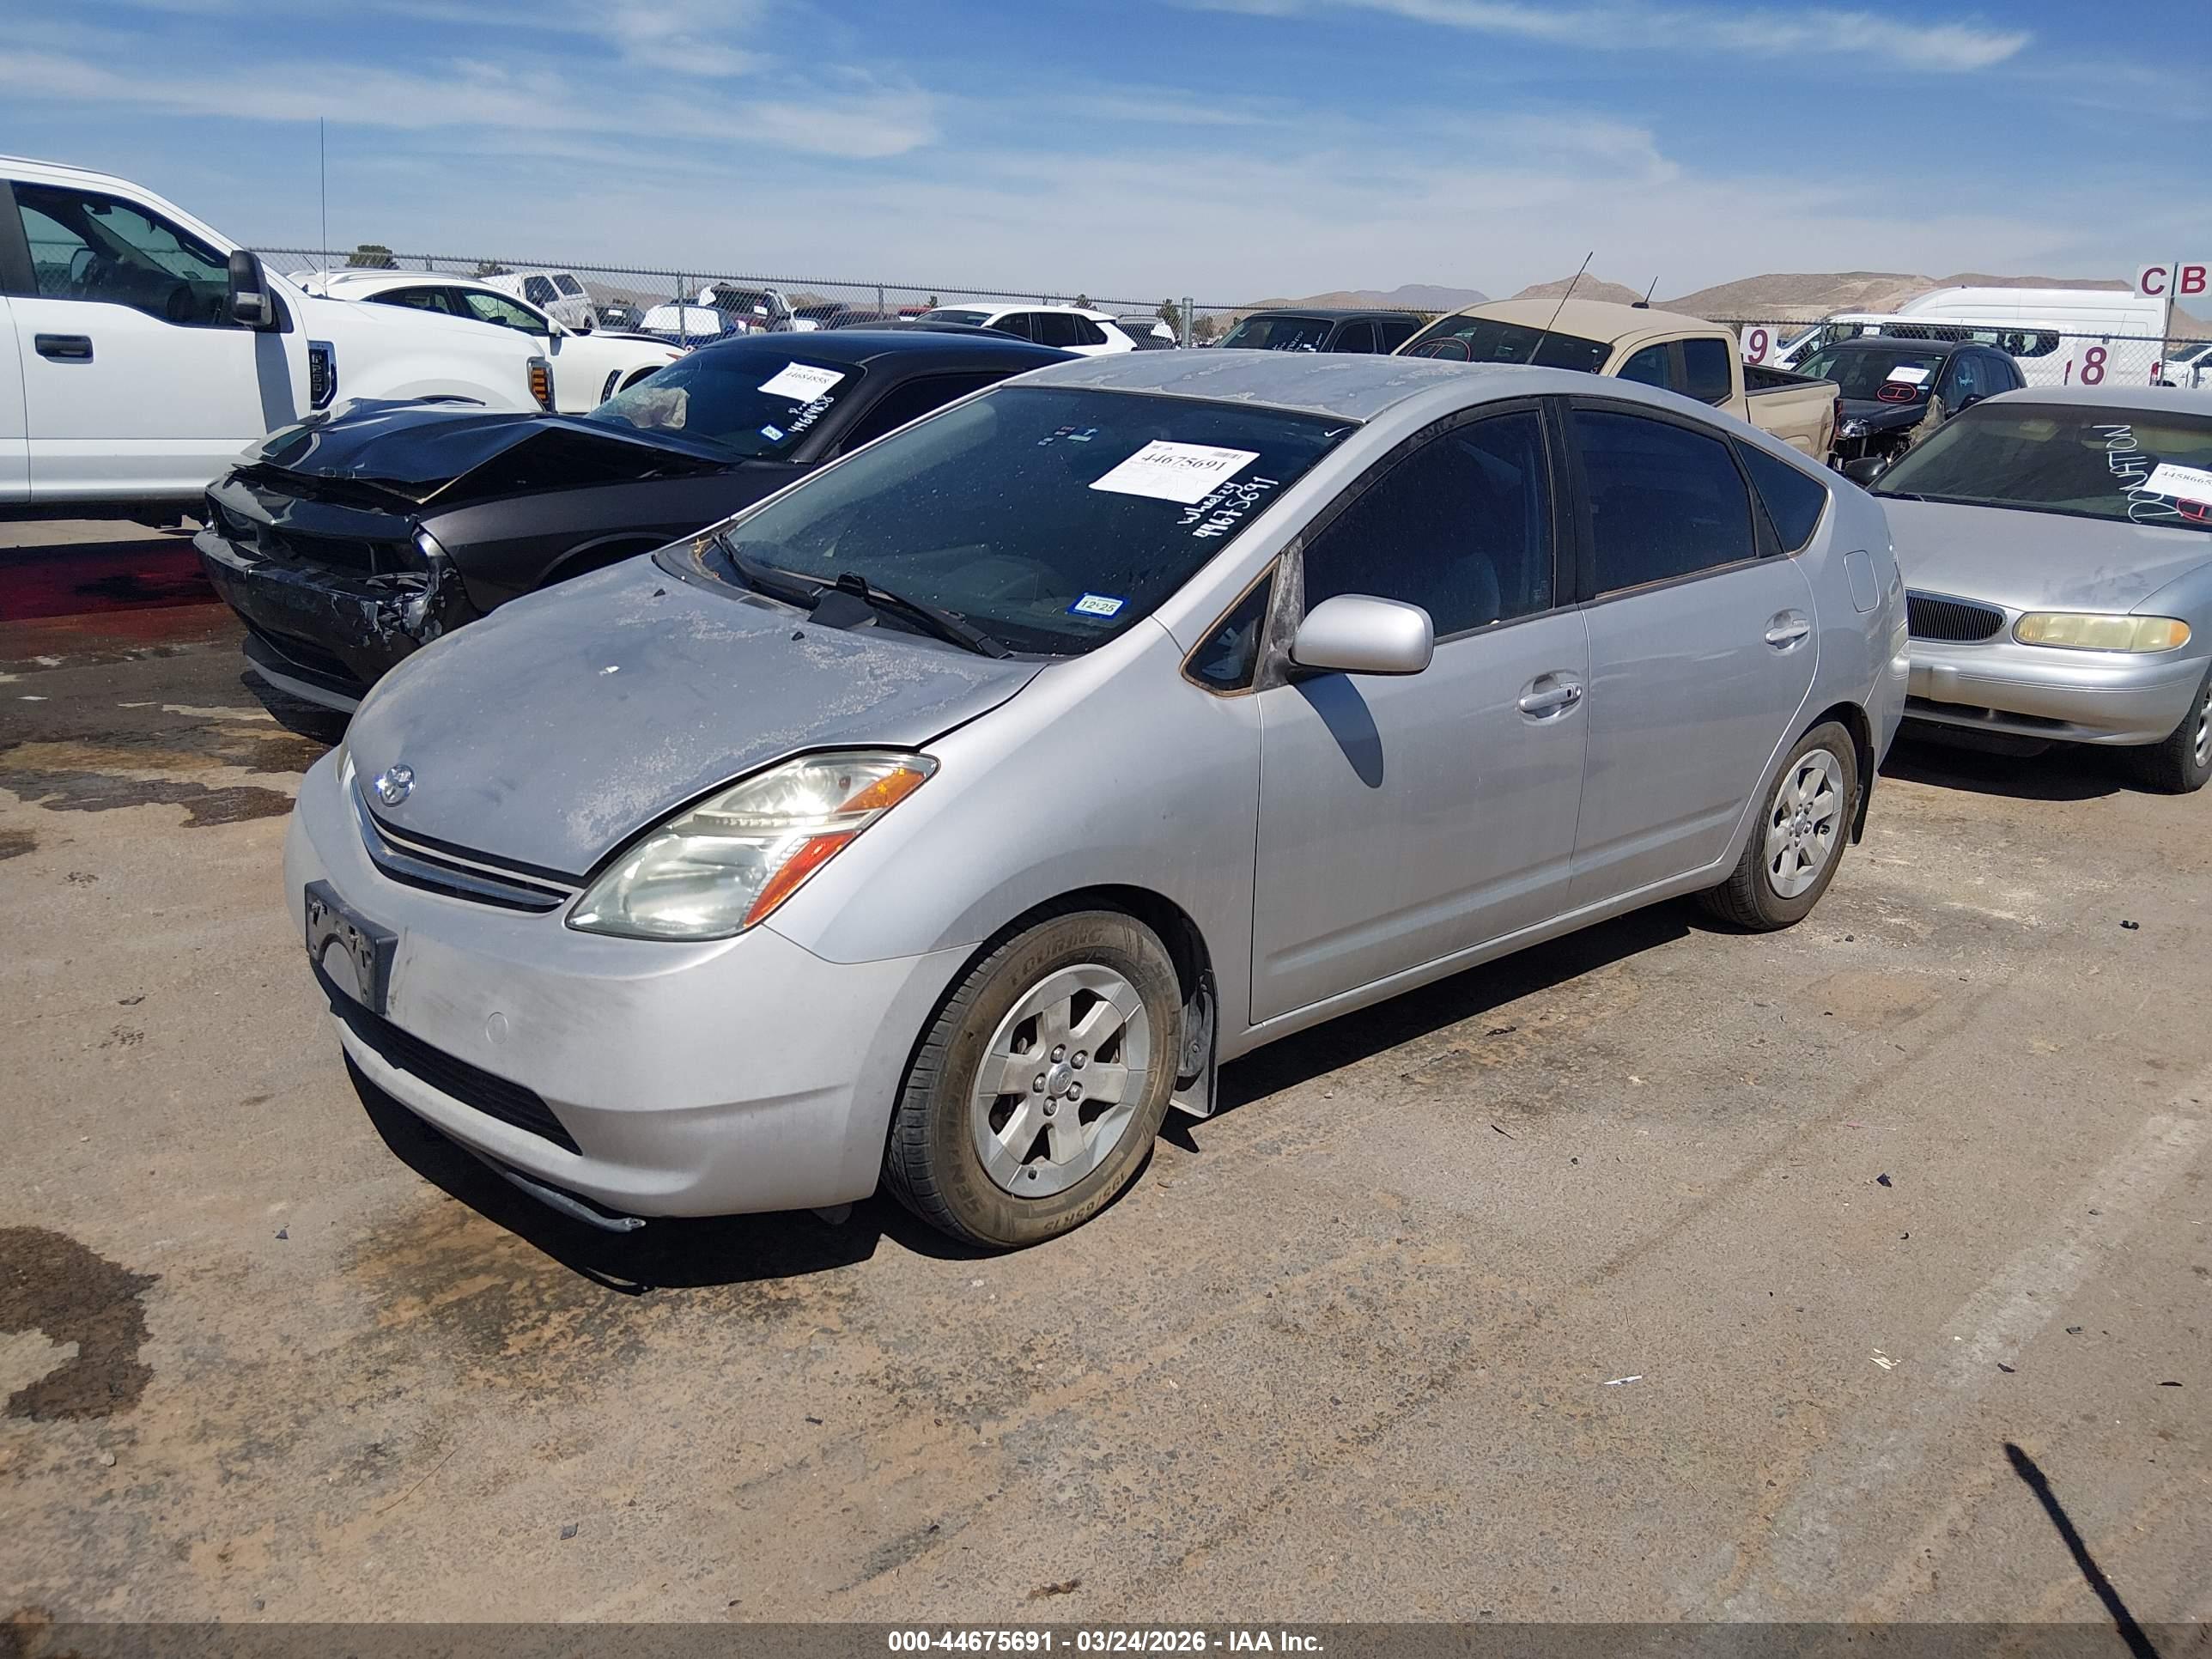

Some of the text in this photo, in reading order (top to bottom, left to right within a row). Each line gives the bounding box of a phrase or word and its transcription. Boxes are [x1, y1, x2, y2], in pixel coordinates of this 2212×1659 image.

[2142, 267, 2166, 295] C
[2180, 266, 2207, 294] B
[1747, 329, 1768, 364] 9
[2081, 346, 2107, 385] 8
[1140, 453, 1228, 472] 44675691
[2092, 424, 2182, 523] DONATION
